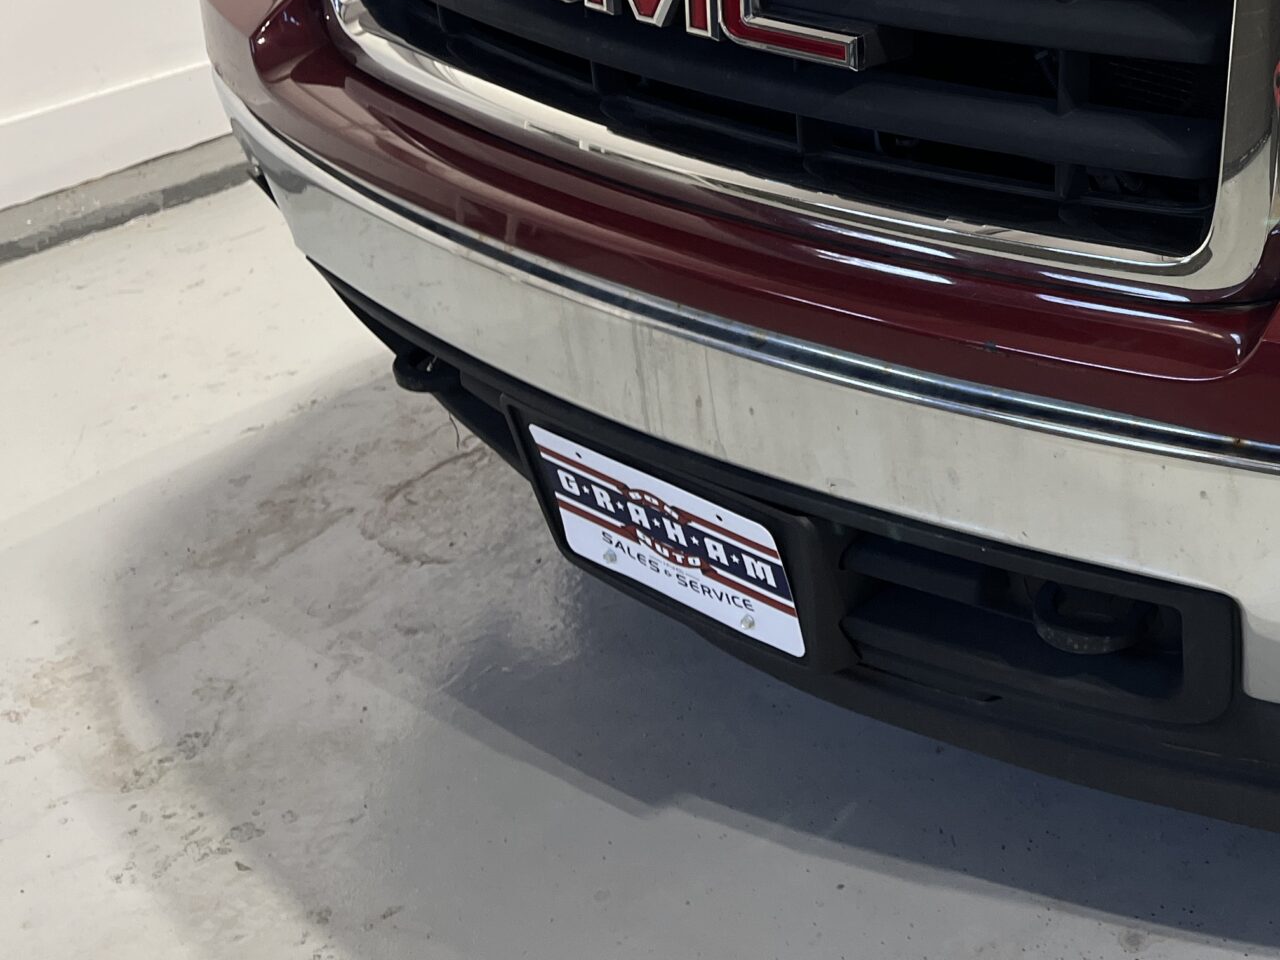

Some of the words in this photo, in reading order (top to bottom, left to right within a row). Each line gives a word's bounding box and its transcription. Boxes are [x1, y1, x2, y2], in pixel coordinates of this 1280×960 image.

[557, 468, 778, 589] GRAHAM
[636, 527, 702, 567] AUTO
[601, 530, 660, 574] SALES
[676, 573, 755, 612] SERVICE
